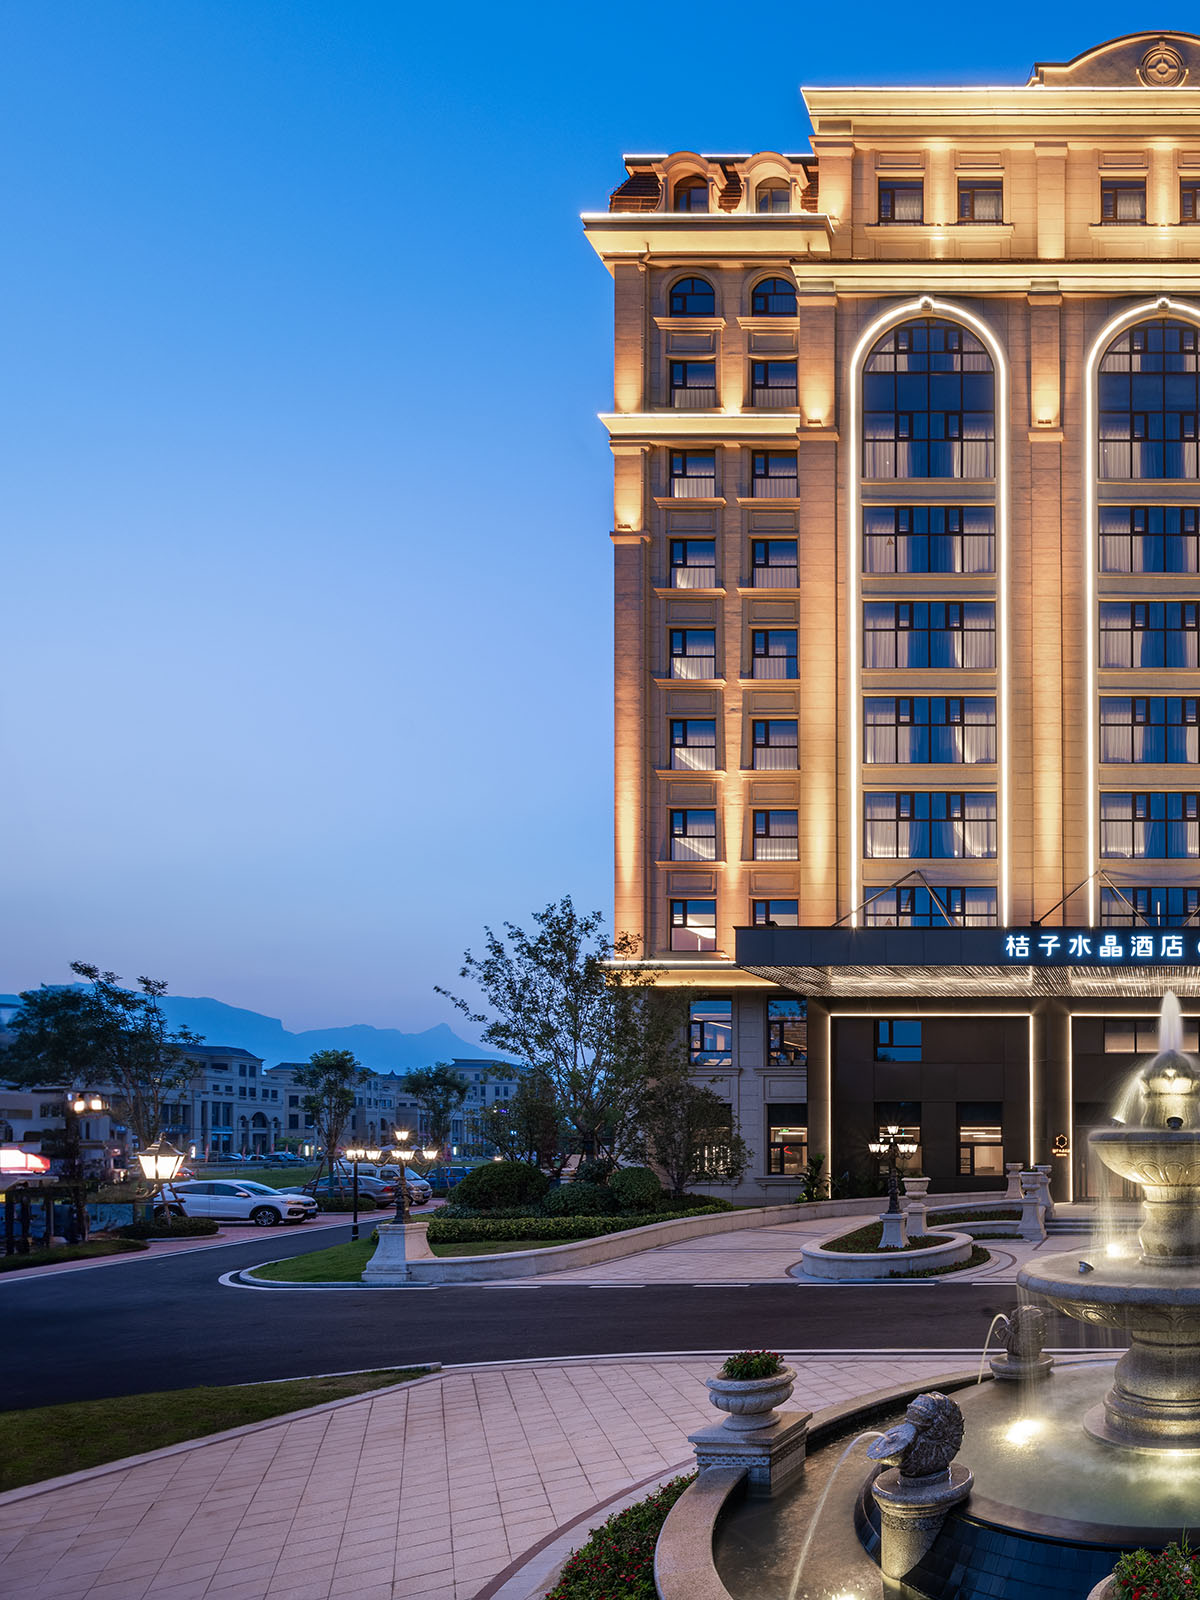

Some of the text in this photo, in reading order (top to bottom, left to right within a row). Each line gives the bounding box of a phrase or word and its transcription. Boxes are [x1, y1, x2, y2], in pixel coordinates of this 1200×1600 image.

[1005, 935, 1184, 958] 桔子水晶酒店
